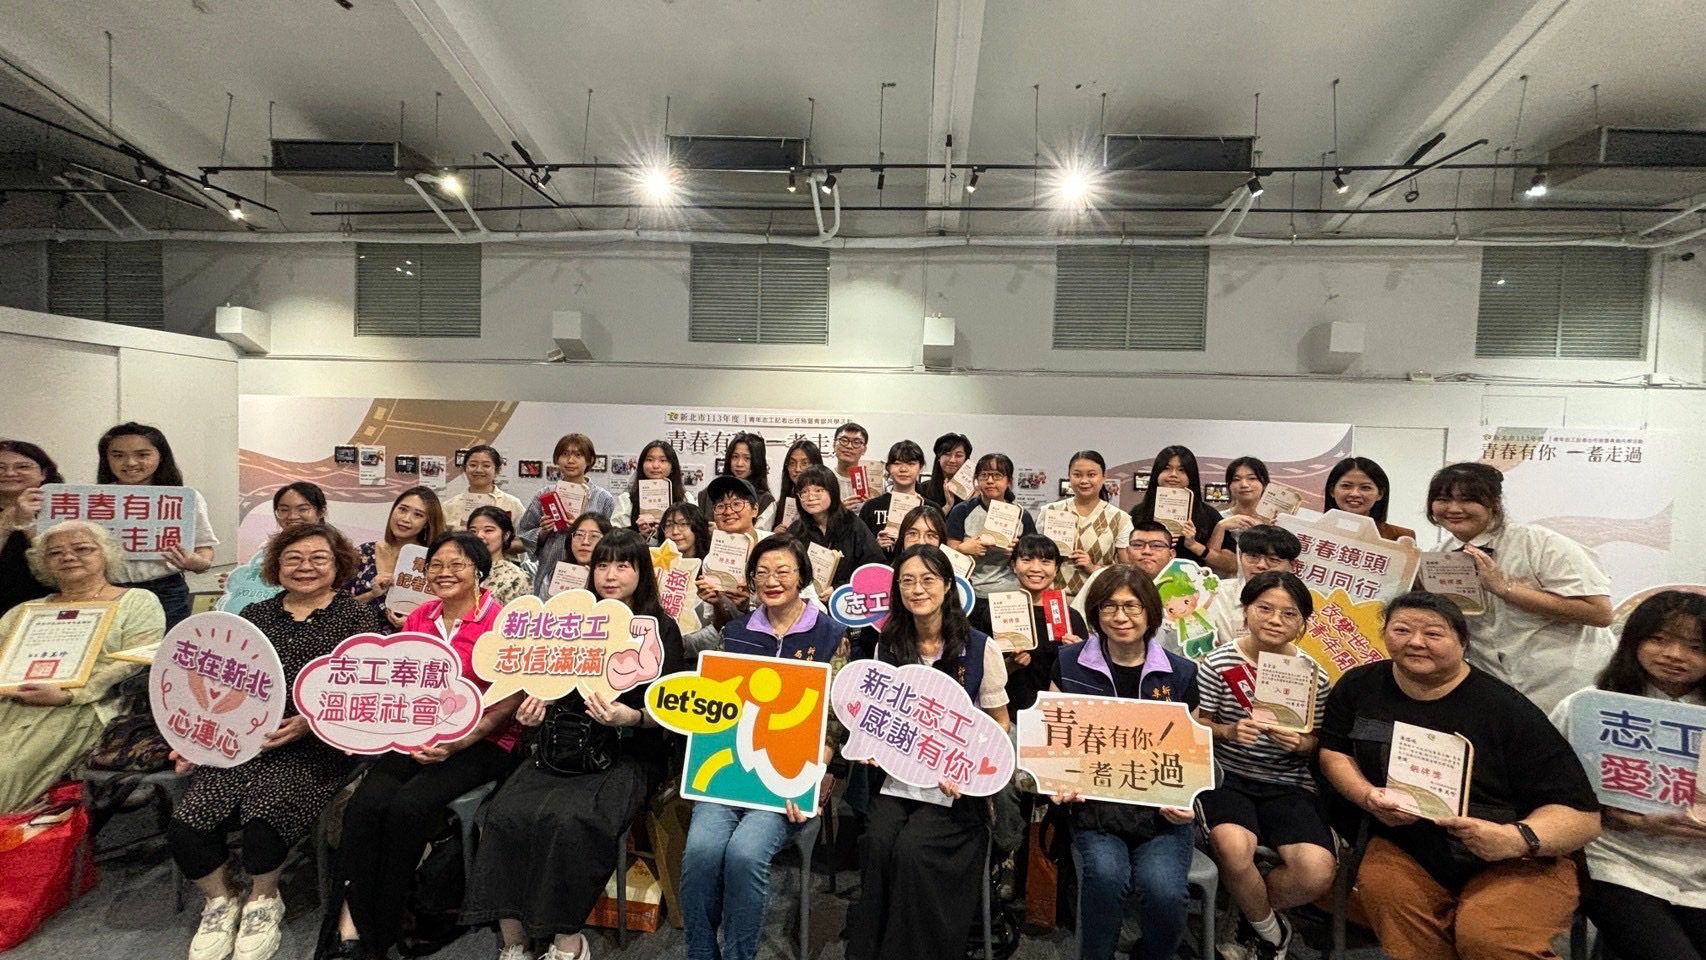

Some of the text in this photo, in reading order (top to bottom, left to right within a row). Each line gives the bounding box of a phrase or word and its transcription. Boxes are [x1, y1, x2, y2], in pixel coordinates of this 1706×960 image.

[666, 430, 762, 453] 青春有
[1482, 443, 1556, 461] 青春有你
[51, 493, 183, 520] 青春有你
[111, 526, 182, 553] 走過
[1296, 533, 1389, 574] 青春鏡頭
[845, 592, 890, 614] 志工
[503, 611, 609, 639] 新北志工
[172, 640, 272, 700] 志在新北
[328, 658, 450, 688] 志工奉獻
[495, 645, 604, 675] 志信滿滿
[317, 693, 439, 726] 溫暖社會
[656, 686, 738, 724] let'sgo
[860, 667, 973, 745] 新北志工
[168, 708, 239, 758] 心連心
[859, 704, 974, 782] 感謝有你
[1041, 707, 1153, 755] 青春有你
[1600, 710, 1704, 759] 志工
